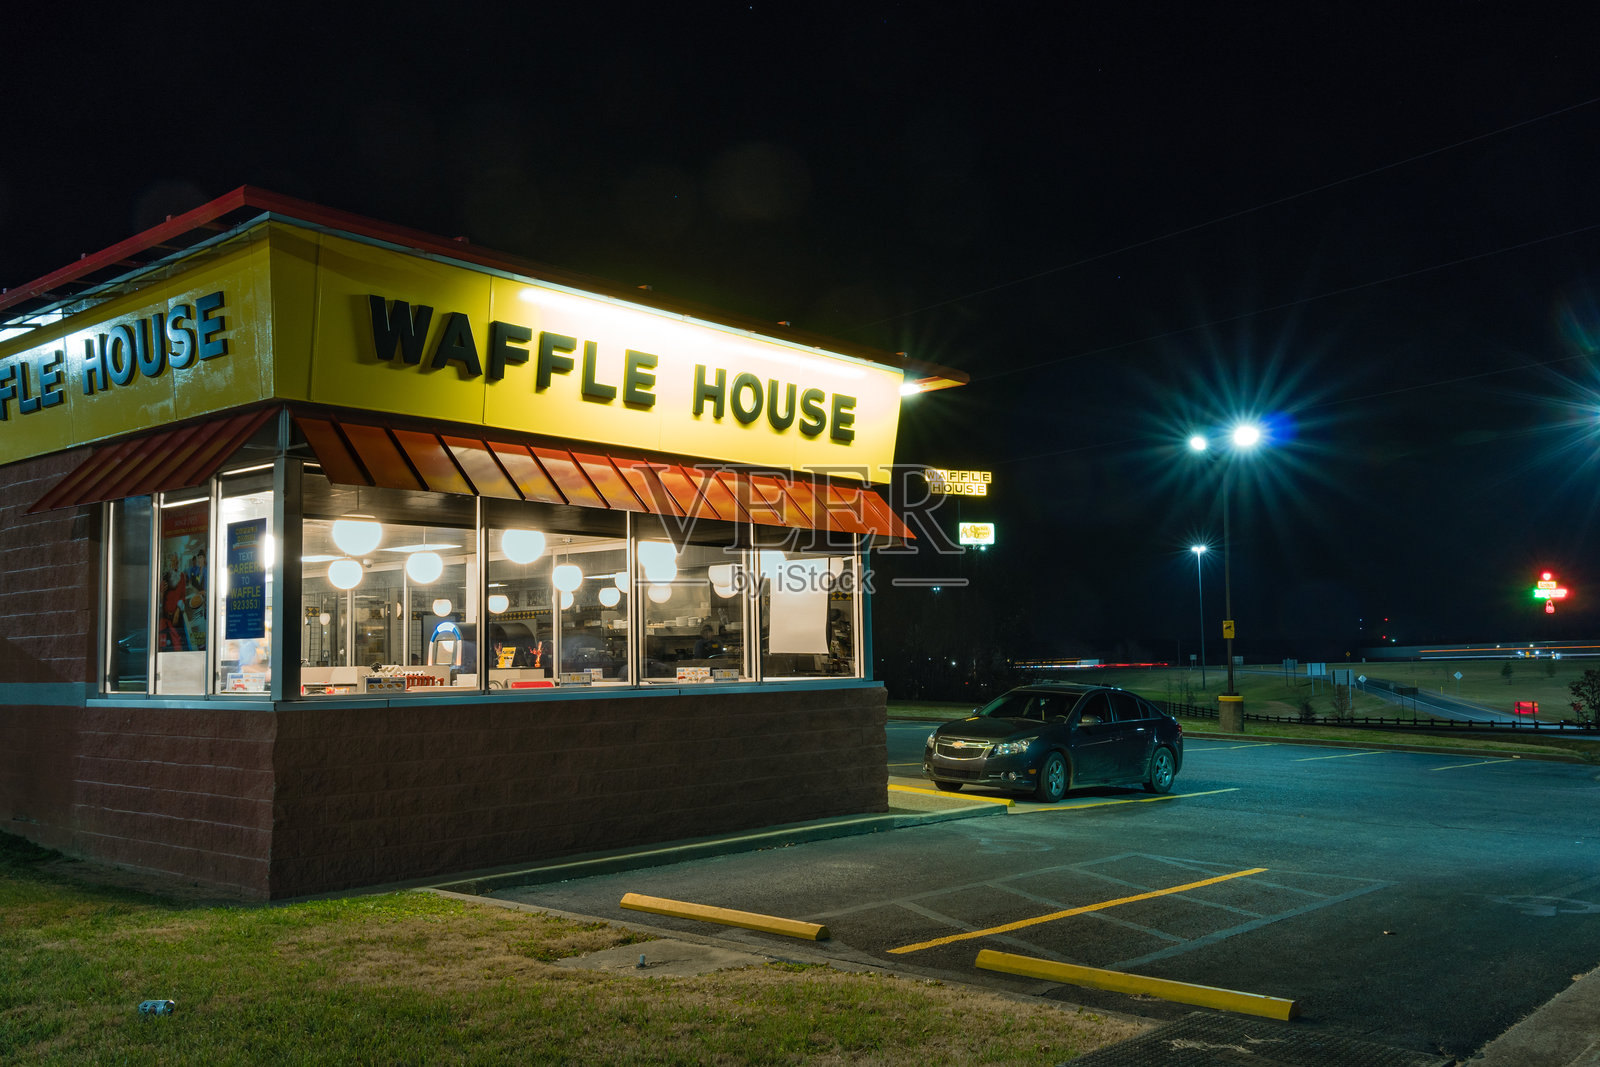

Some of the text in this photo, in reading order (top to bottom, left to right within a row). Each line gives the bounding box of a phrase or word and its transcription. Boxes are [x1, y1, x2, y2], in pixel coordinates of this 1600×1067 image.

[82, 291, 228, 395] HOUSE
[368, 294, 857, 444] WAFFLE HOUSE
[926, 471, 990, 482] WAFFLE
[932, 483, 985, 494] HOUSE
[238, 552, 254, 561] TEXT
[241, 576, 250, 585] TO
[231, 585, 261, 599] WAFFLE
